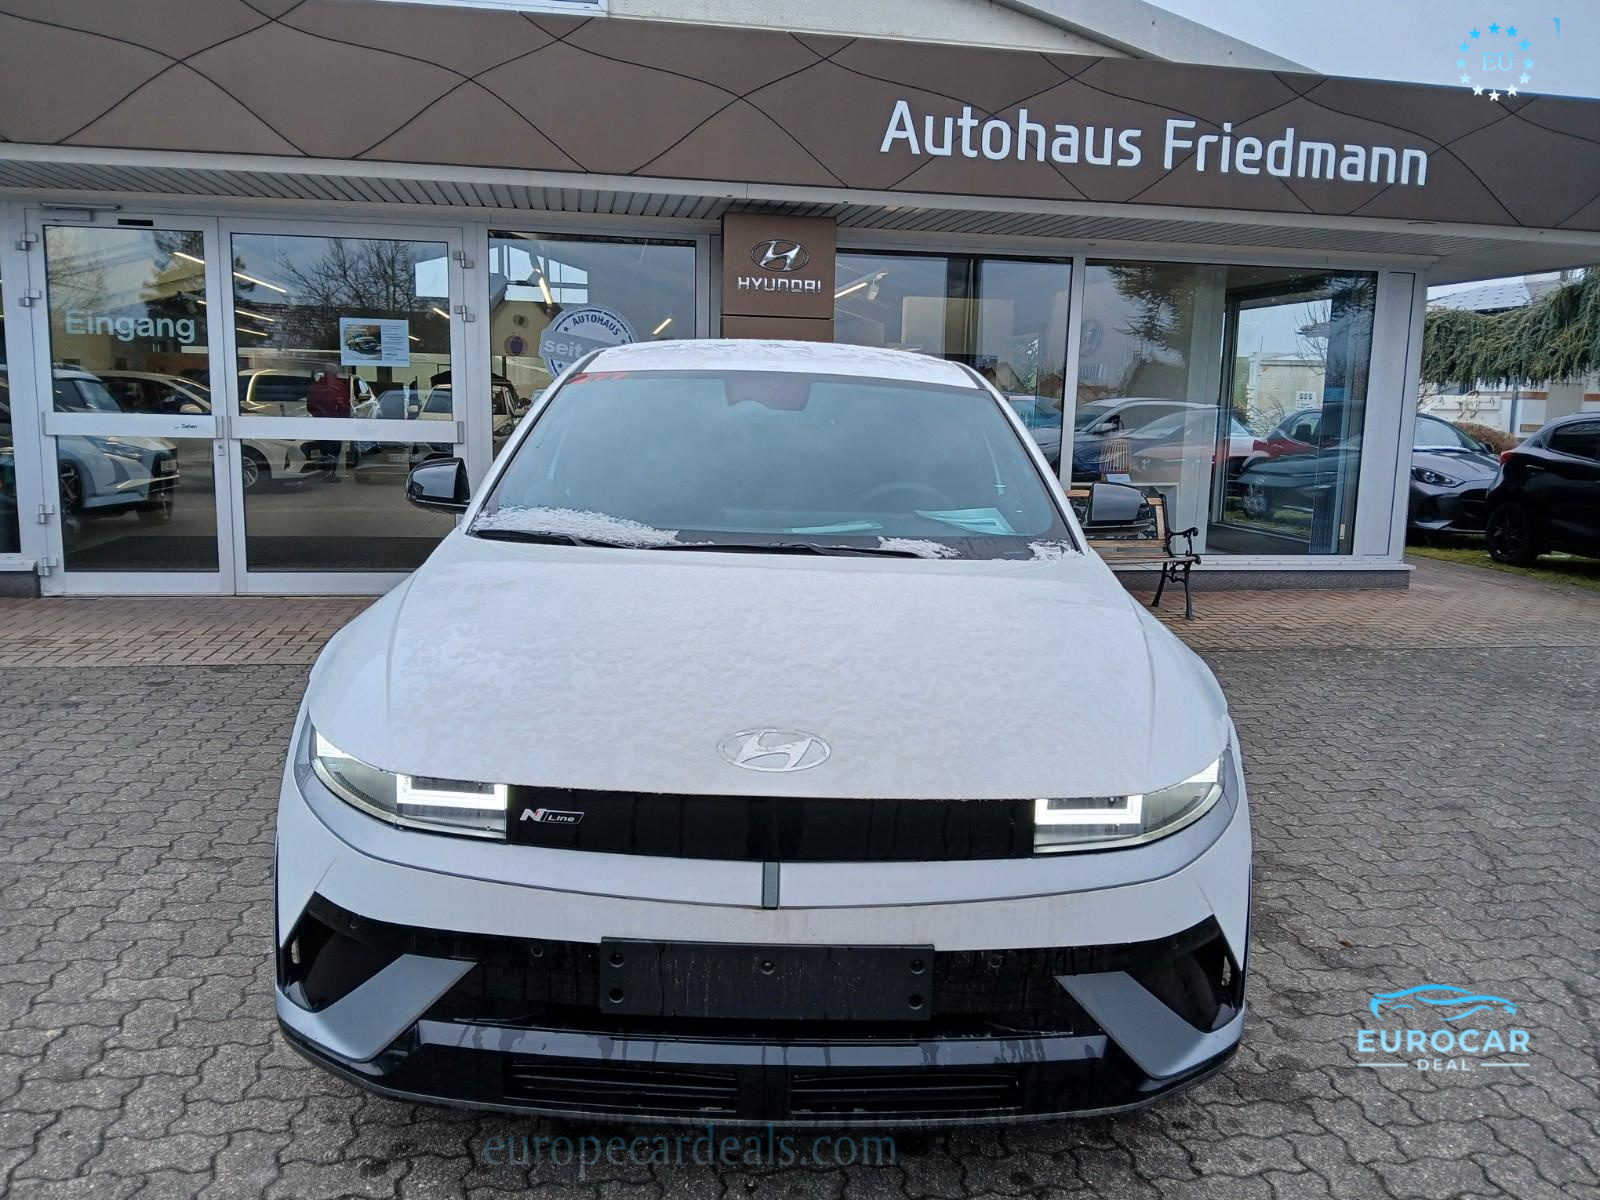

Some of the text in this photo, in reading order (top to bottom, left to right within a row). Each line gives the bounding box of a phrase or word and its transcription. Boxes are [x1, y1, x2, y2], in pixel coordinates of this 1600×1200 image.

[879, 100, 1428, 186] Autohaus Friedmann
[737, 276, 821, 293] HYUNDAI
[65, 309, 195, 344] Eingang
[572, 314, 622, 336] AUTOHAUS
[543, 340, 583, 359] seit
[547, 814, 575, 822] Line
